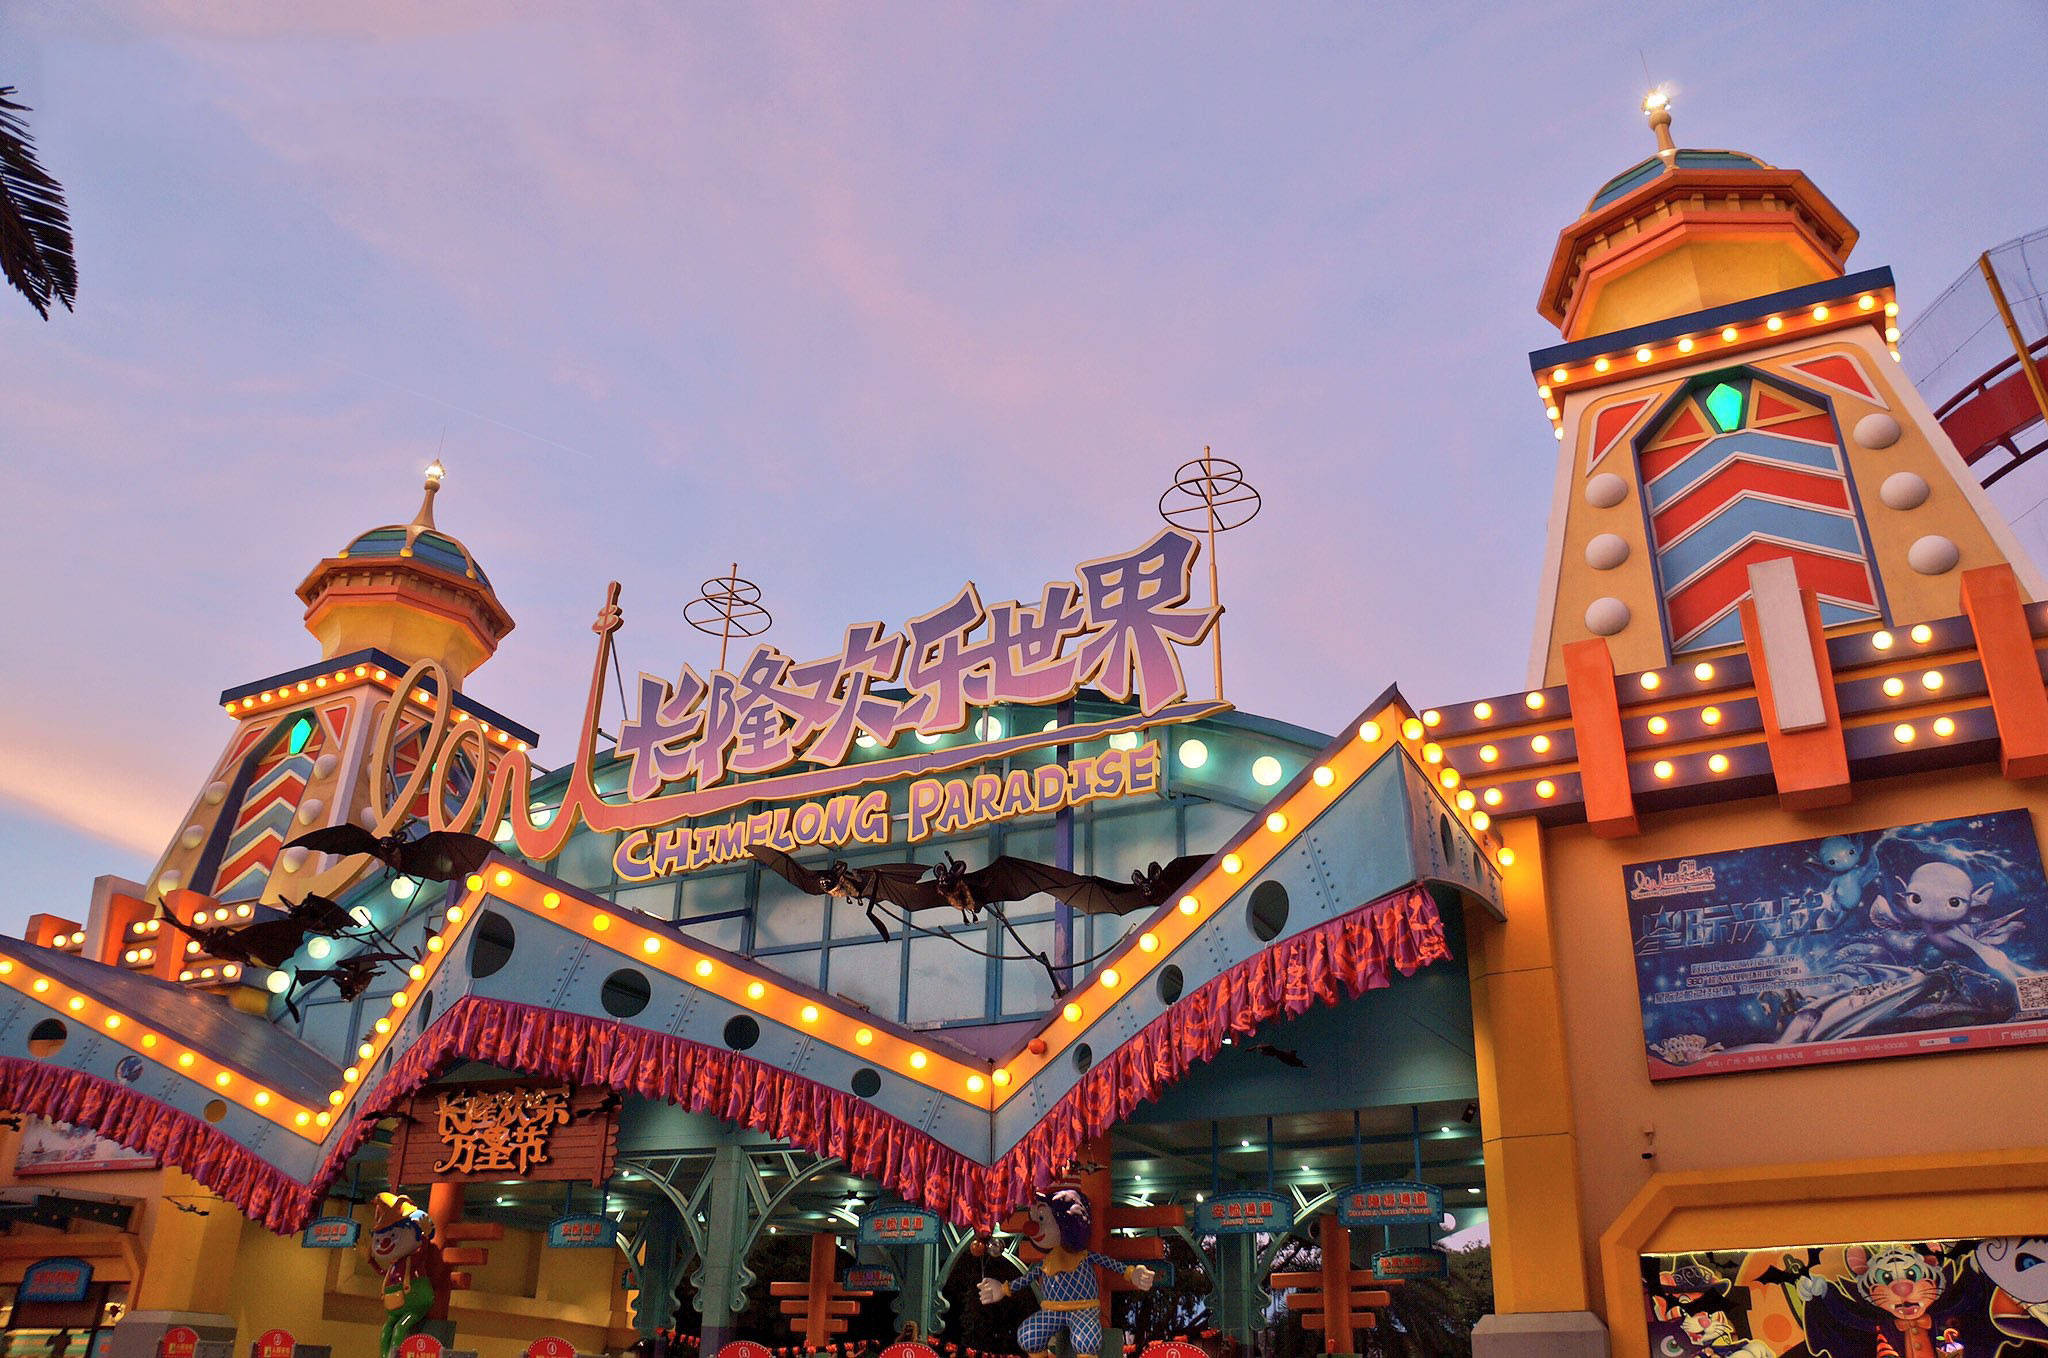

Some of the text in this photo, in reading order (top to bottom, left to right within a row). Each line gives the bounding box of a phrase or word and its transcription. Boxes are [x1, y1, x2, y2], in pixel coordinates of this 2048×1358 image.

[614, 526, 1226, 803] 长隆欢乐世界
[612, 739, 1163, 884] CHIMELONG PARADISE
[433, 1126, 549, 1174] 万圣节
